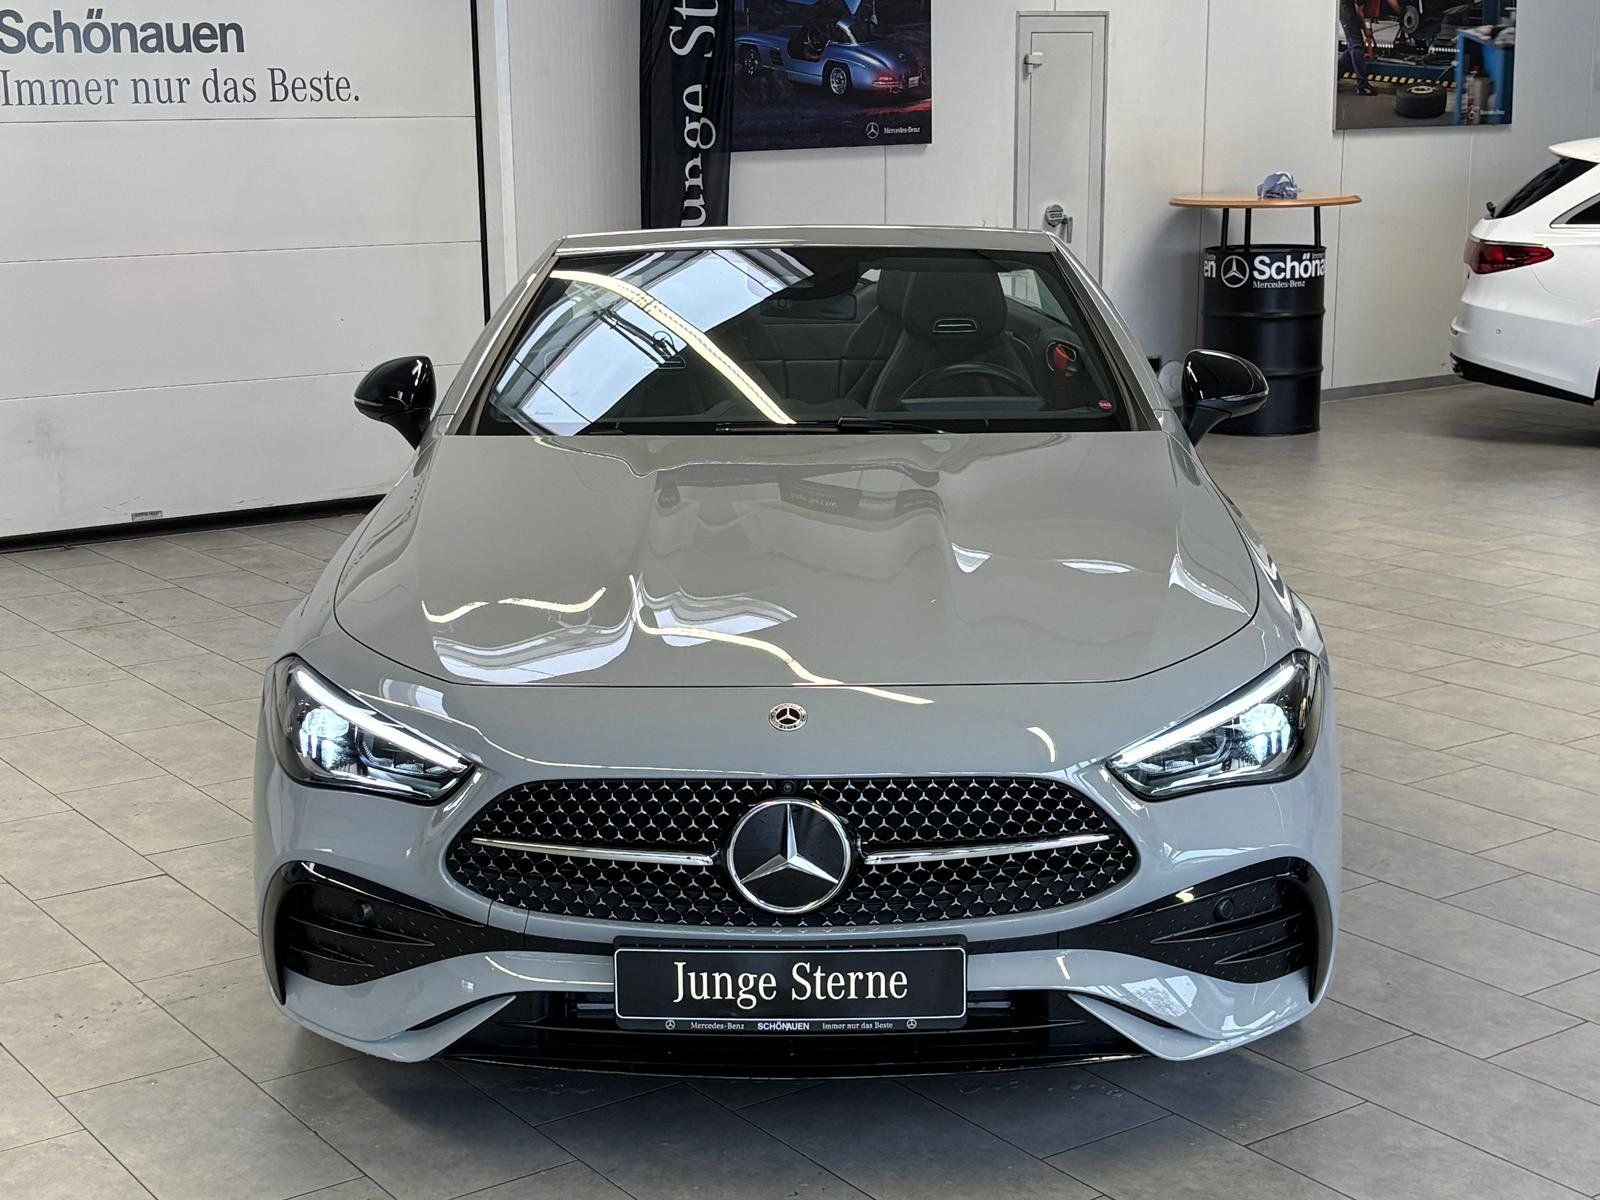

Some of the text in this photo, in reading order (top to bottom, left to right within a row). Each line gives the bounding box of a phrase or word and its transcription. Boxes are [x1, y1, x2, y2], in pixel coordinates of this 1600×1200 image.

[0, 8, 245, 54] Schönauen
[0, 67, 360, 106] Immer nur das Beste.
[680, 84, 717, 228] unge
[1252, 280, 1305, 288] Mercedes-Benz
[673, 961, 908, 1010] Junge Sterne
[690, 1022, 745, 1030] Mercedes-Benz
[757, 1020, 810, 1031] SCHÖNAUEN
[822, 1022, 845, 1030] Immer
